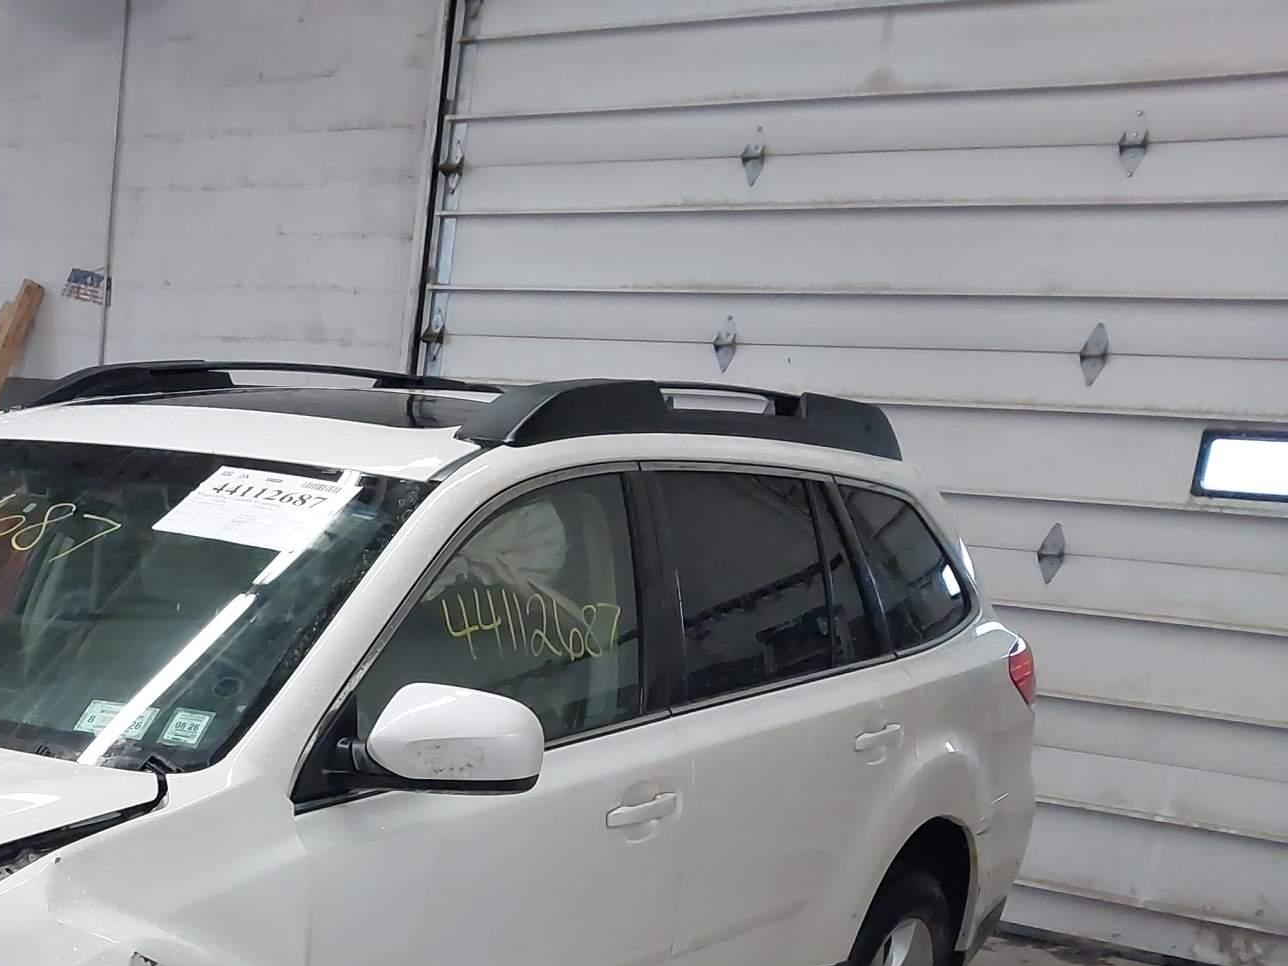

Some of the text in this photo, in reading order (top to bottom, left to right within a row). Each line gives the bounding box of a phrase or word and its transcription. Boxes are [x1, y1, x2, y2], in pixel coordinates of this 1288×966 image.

[212, 482, 329, 509] 44112687
[441, 587, 622, 662] 44112687
[127, 720, 143, 730] 26
[174, 721, 187, 730] 08
